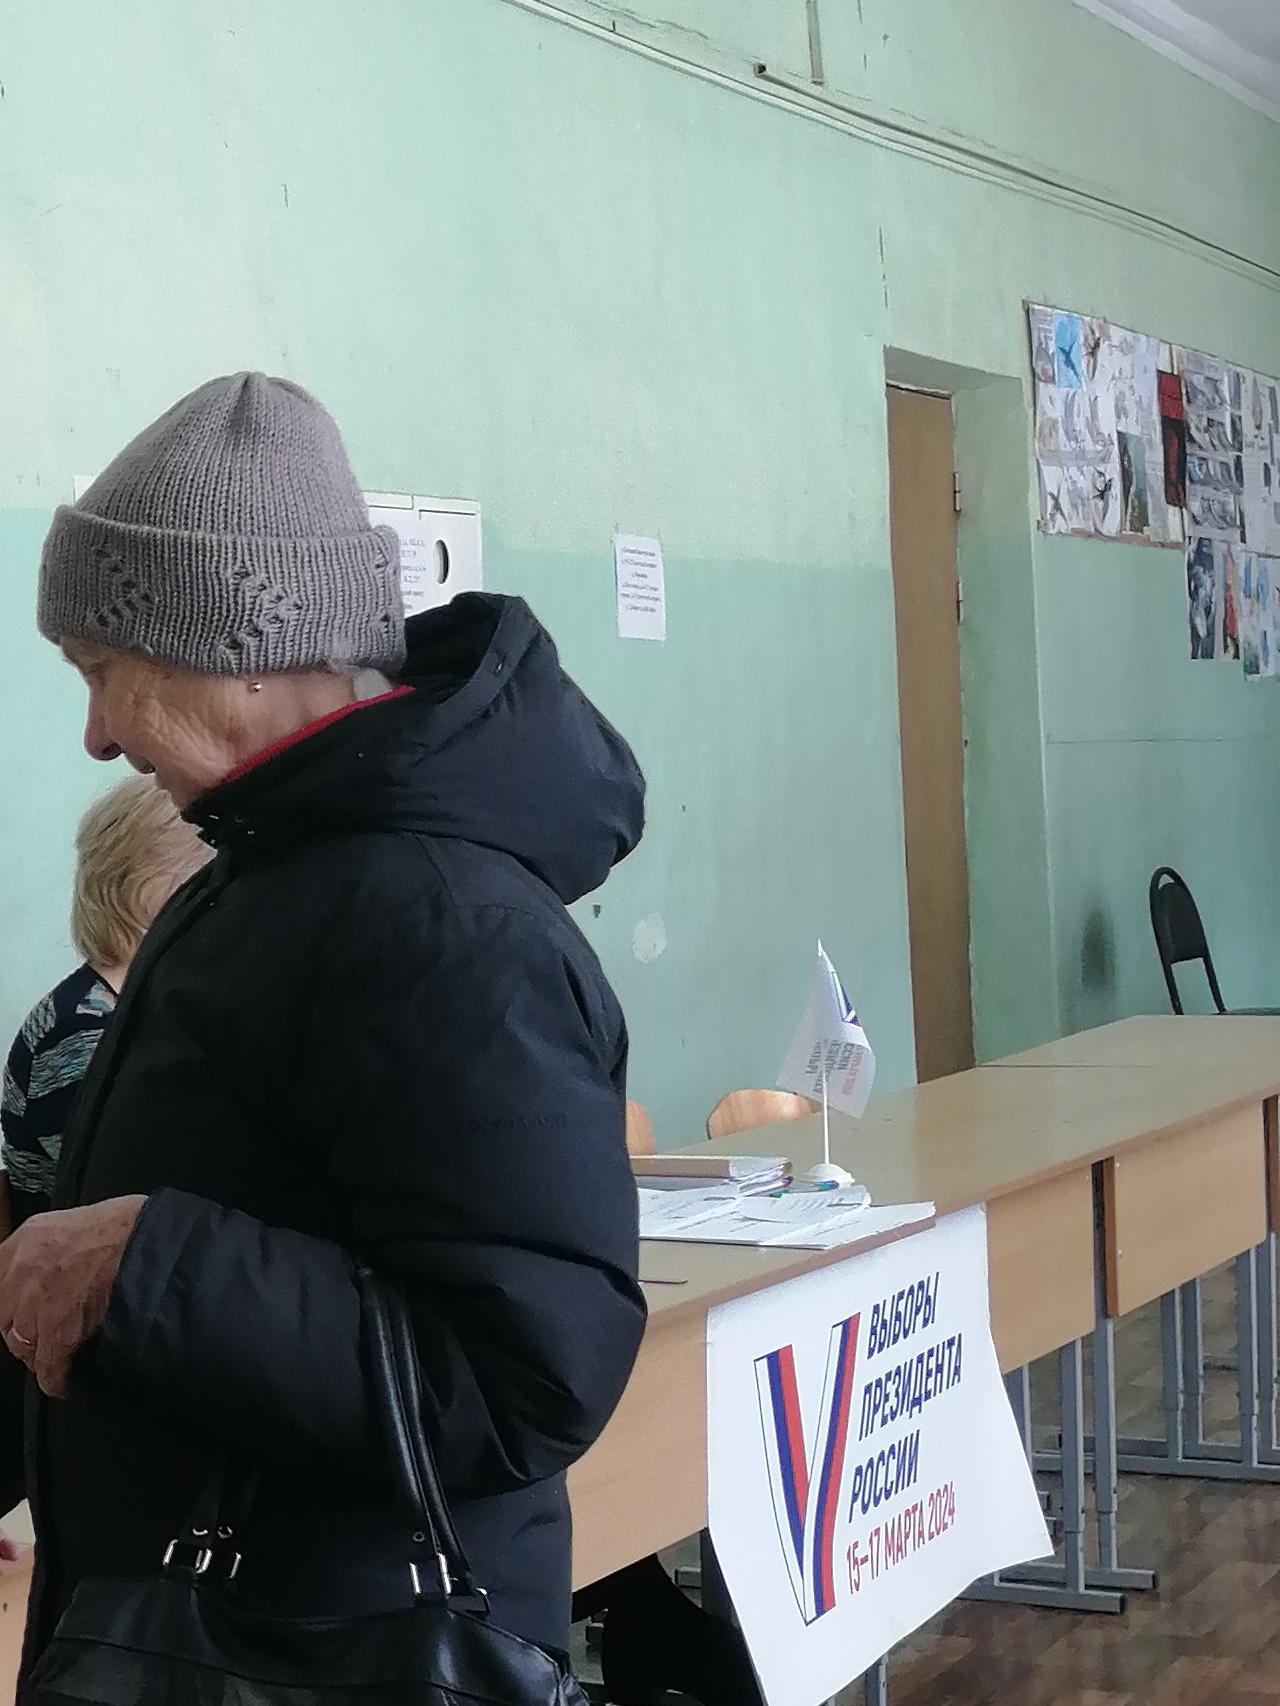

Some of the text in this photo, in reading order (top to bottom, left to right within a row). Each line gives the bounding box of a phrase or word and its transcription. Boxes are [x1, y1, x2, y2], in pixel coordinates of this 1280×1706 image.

[867, 1271, 940, 1360] ВЫБОРЫ
[858, 1332, 962, 1441] ПРЕЗИДЕНТА
[848, 1429, 920, 1524] РОССИИ
[885, 1499, 925, 1570] МАРТА
[928, 1480, 955, 1541] 2024
